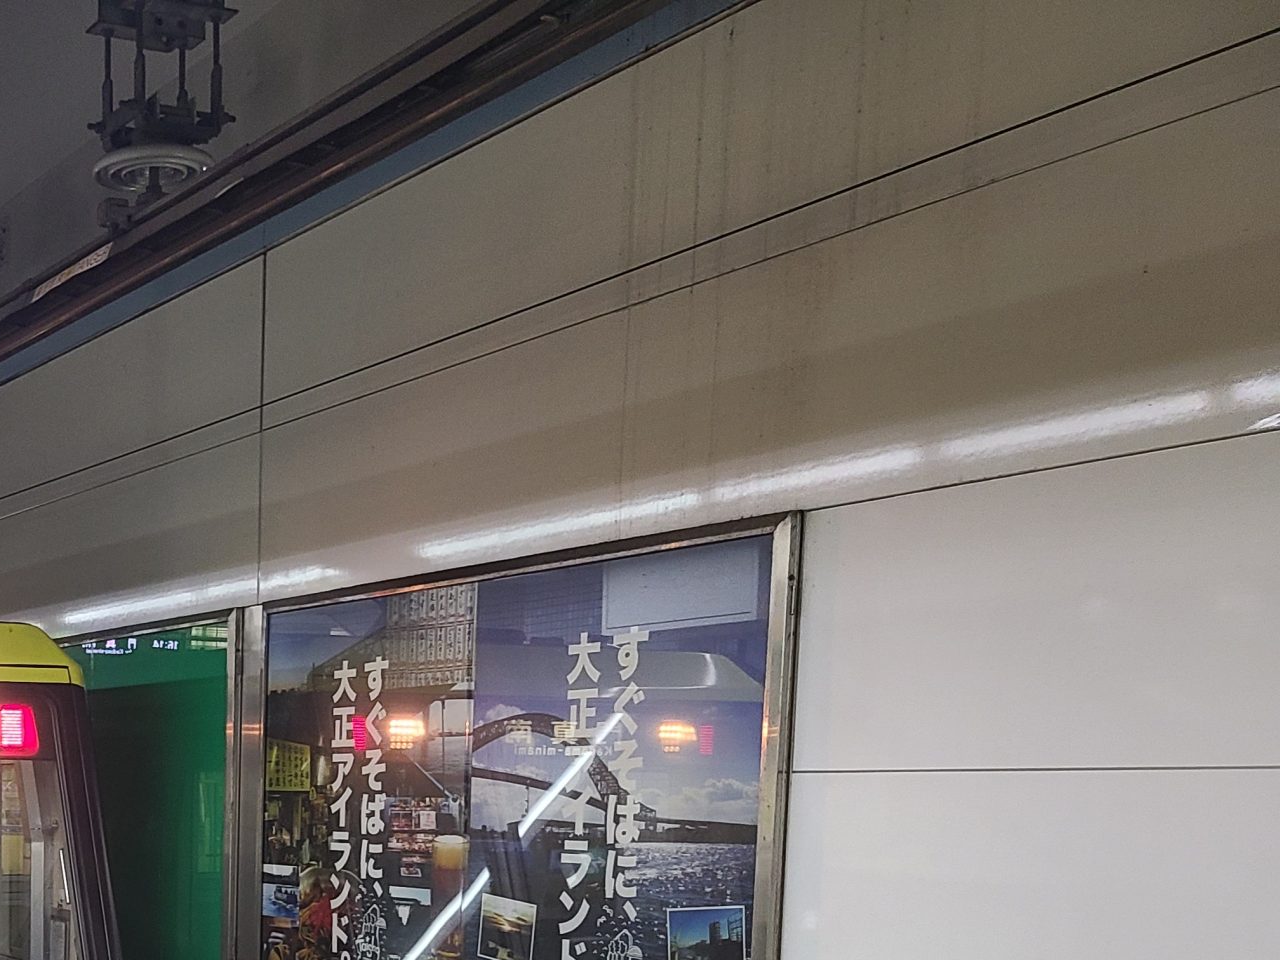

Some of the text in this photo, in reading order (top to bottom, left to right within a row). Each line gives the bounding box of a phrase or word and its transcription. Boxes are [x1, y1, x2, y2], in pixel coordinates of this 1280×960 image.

[361, 656, 389, 897] すぐそばに、
[605, 626, 649, 922] すぐそばに、
